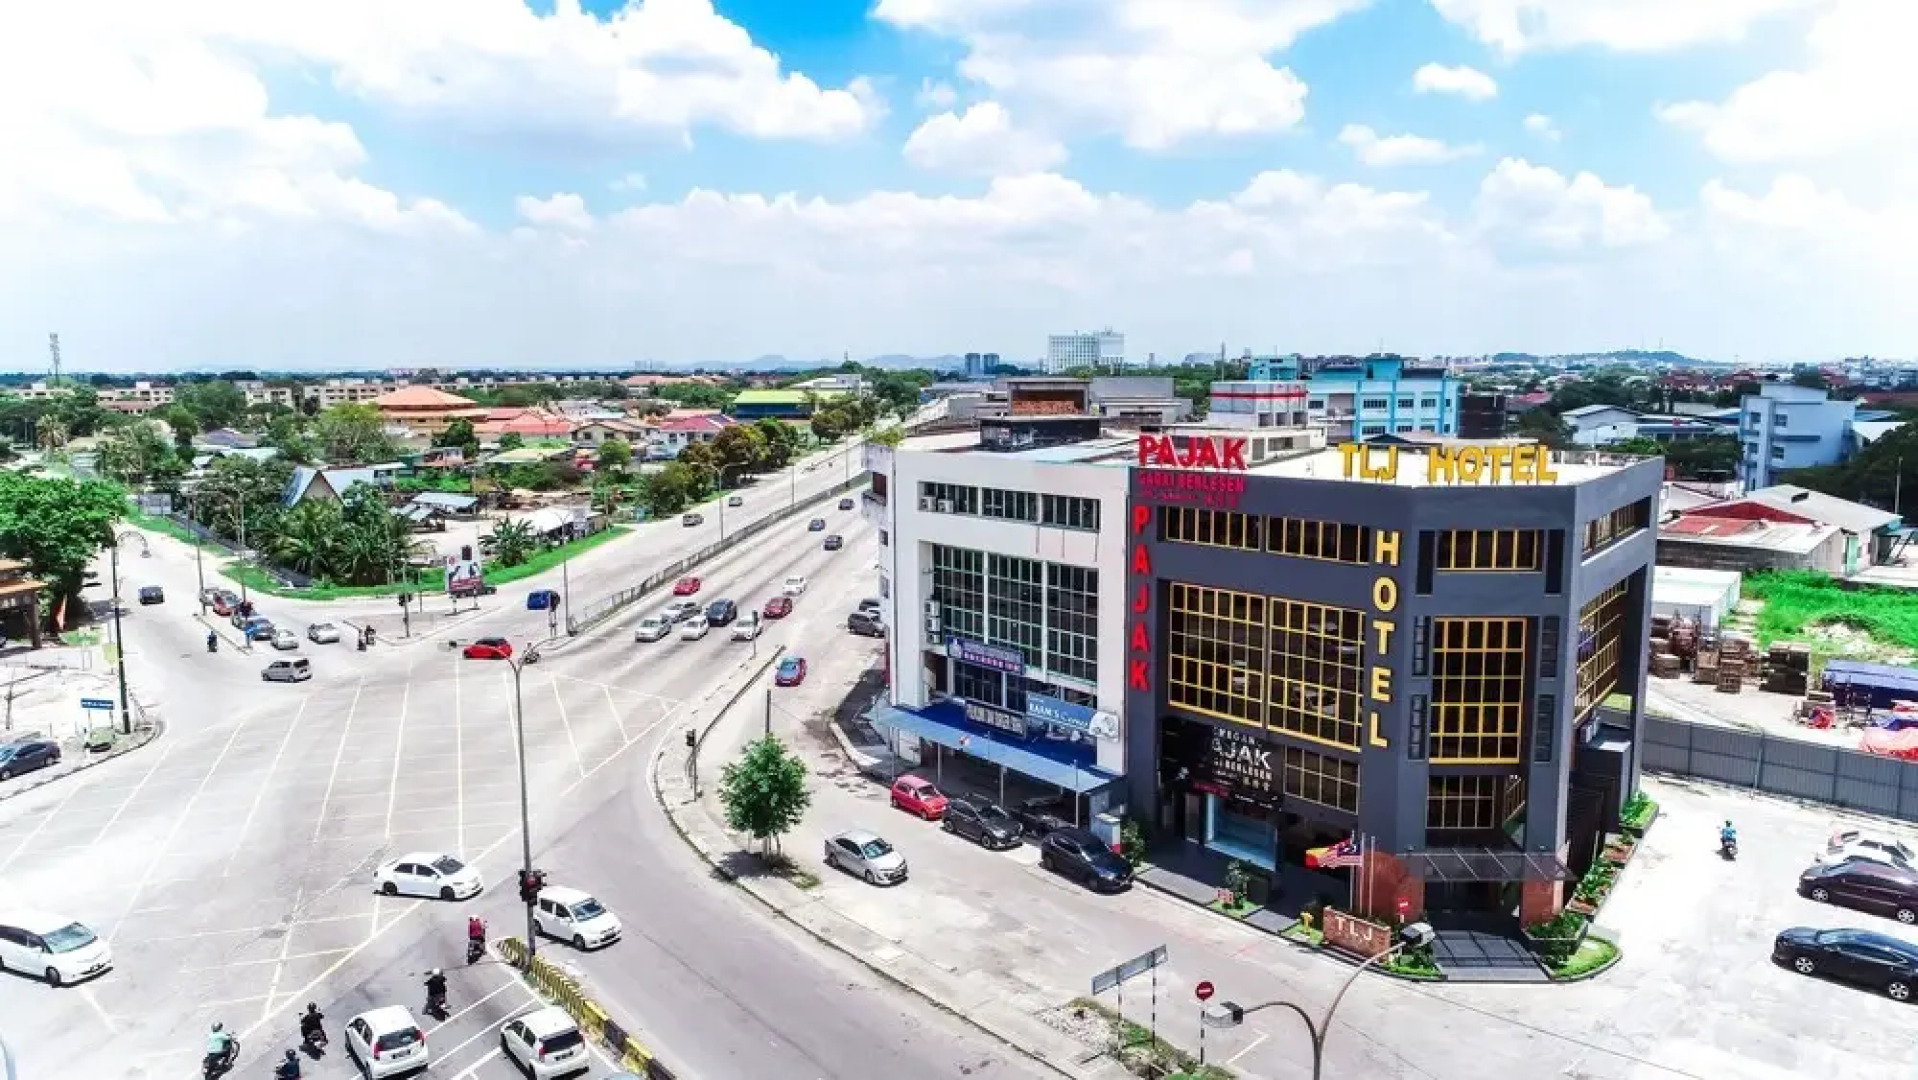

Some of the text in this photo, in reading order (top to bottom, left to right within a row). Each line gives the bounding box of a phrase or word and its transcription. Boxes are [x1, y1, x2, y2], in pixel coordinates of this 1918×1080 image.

[1138, 434, 1247, 470] PAJAK
[1338, 442, 1558, 484] TLJ HOTEL
[1177, 473, 1244, 492] BERLESEN
[1130, 505, 1151, 692] PAJAK
[1368, 528, 1400, 748] HOTEL
[1334, 916, 1373, 941] TLJ
